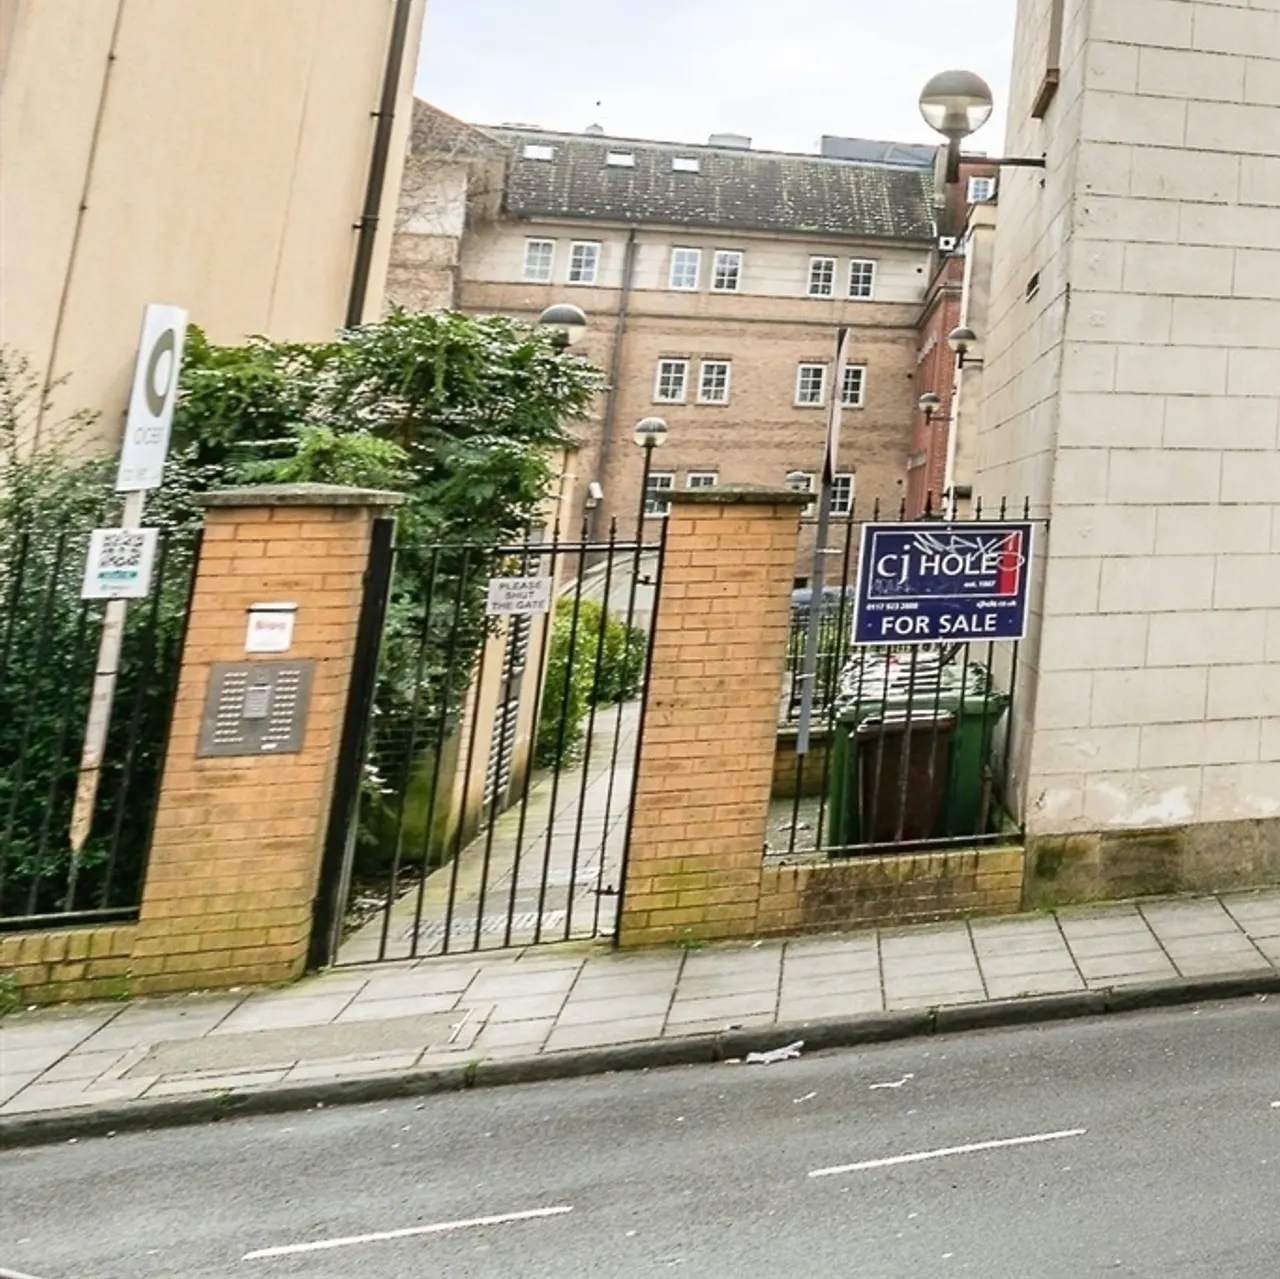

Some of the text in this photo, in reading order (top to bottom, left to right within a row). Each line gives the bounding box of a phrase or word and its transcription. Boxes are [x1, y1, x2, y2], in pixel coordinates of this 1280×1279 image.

[919, 552, 998, 576] HOLE
[499, 581, 542, 590] PLEASE
[504, 591, 534, 600] SHUT
[492, 600, 545, 610] THE GATE
[881, 613, 998, 636] FOR SALE
